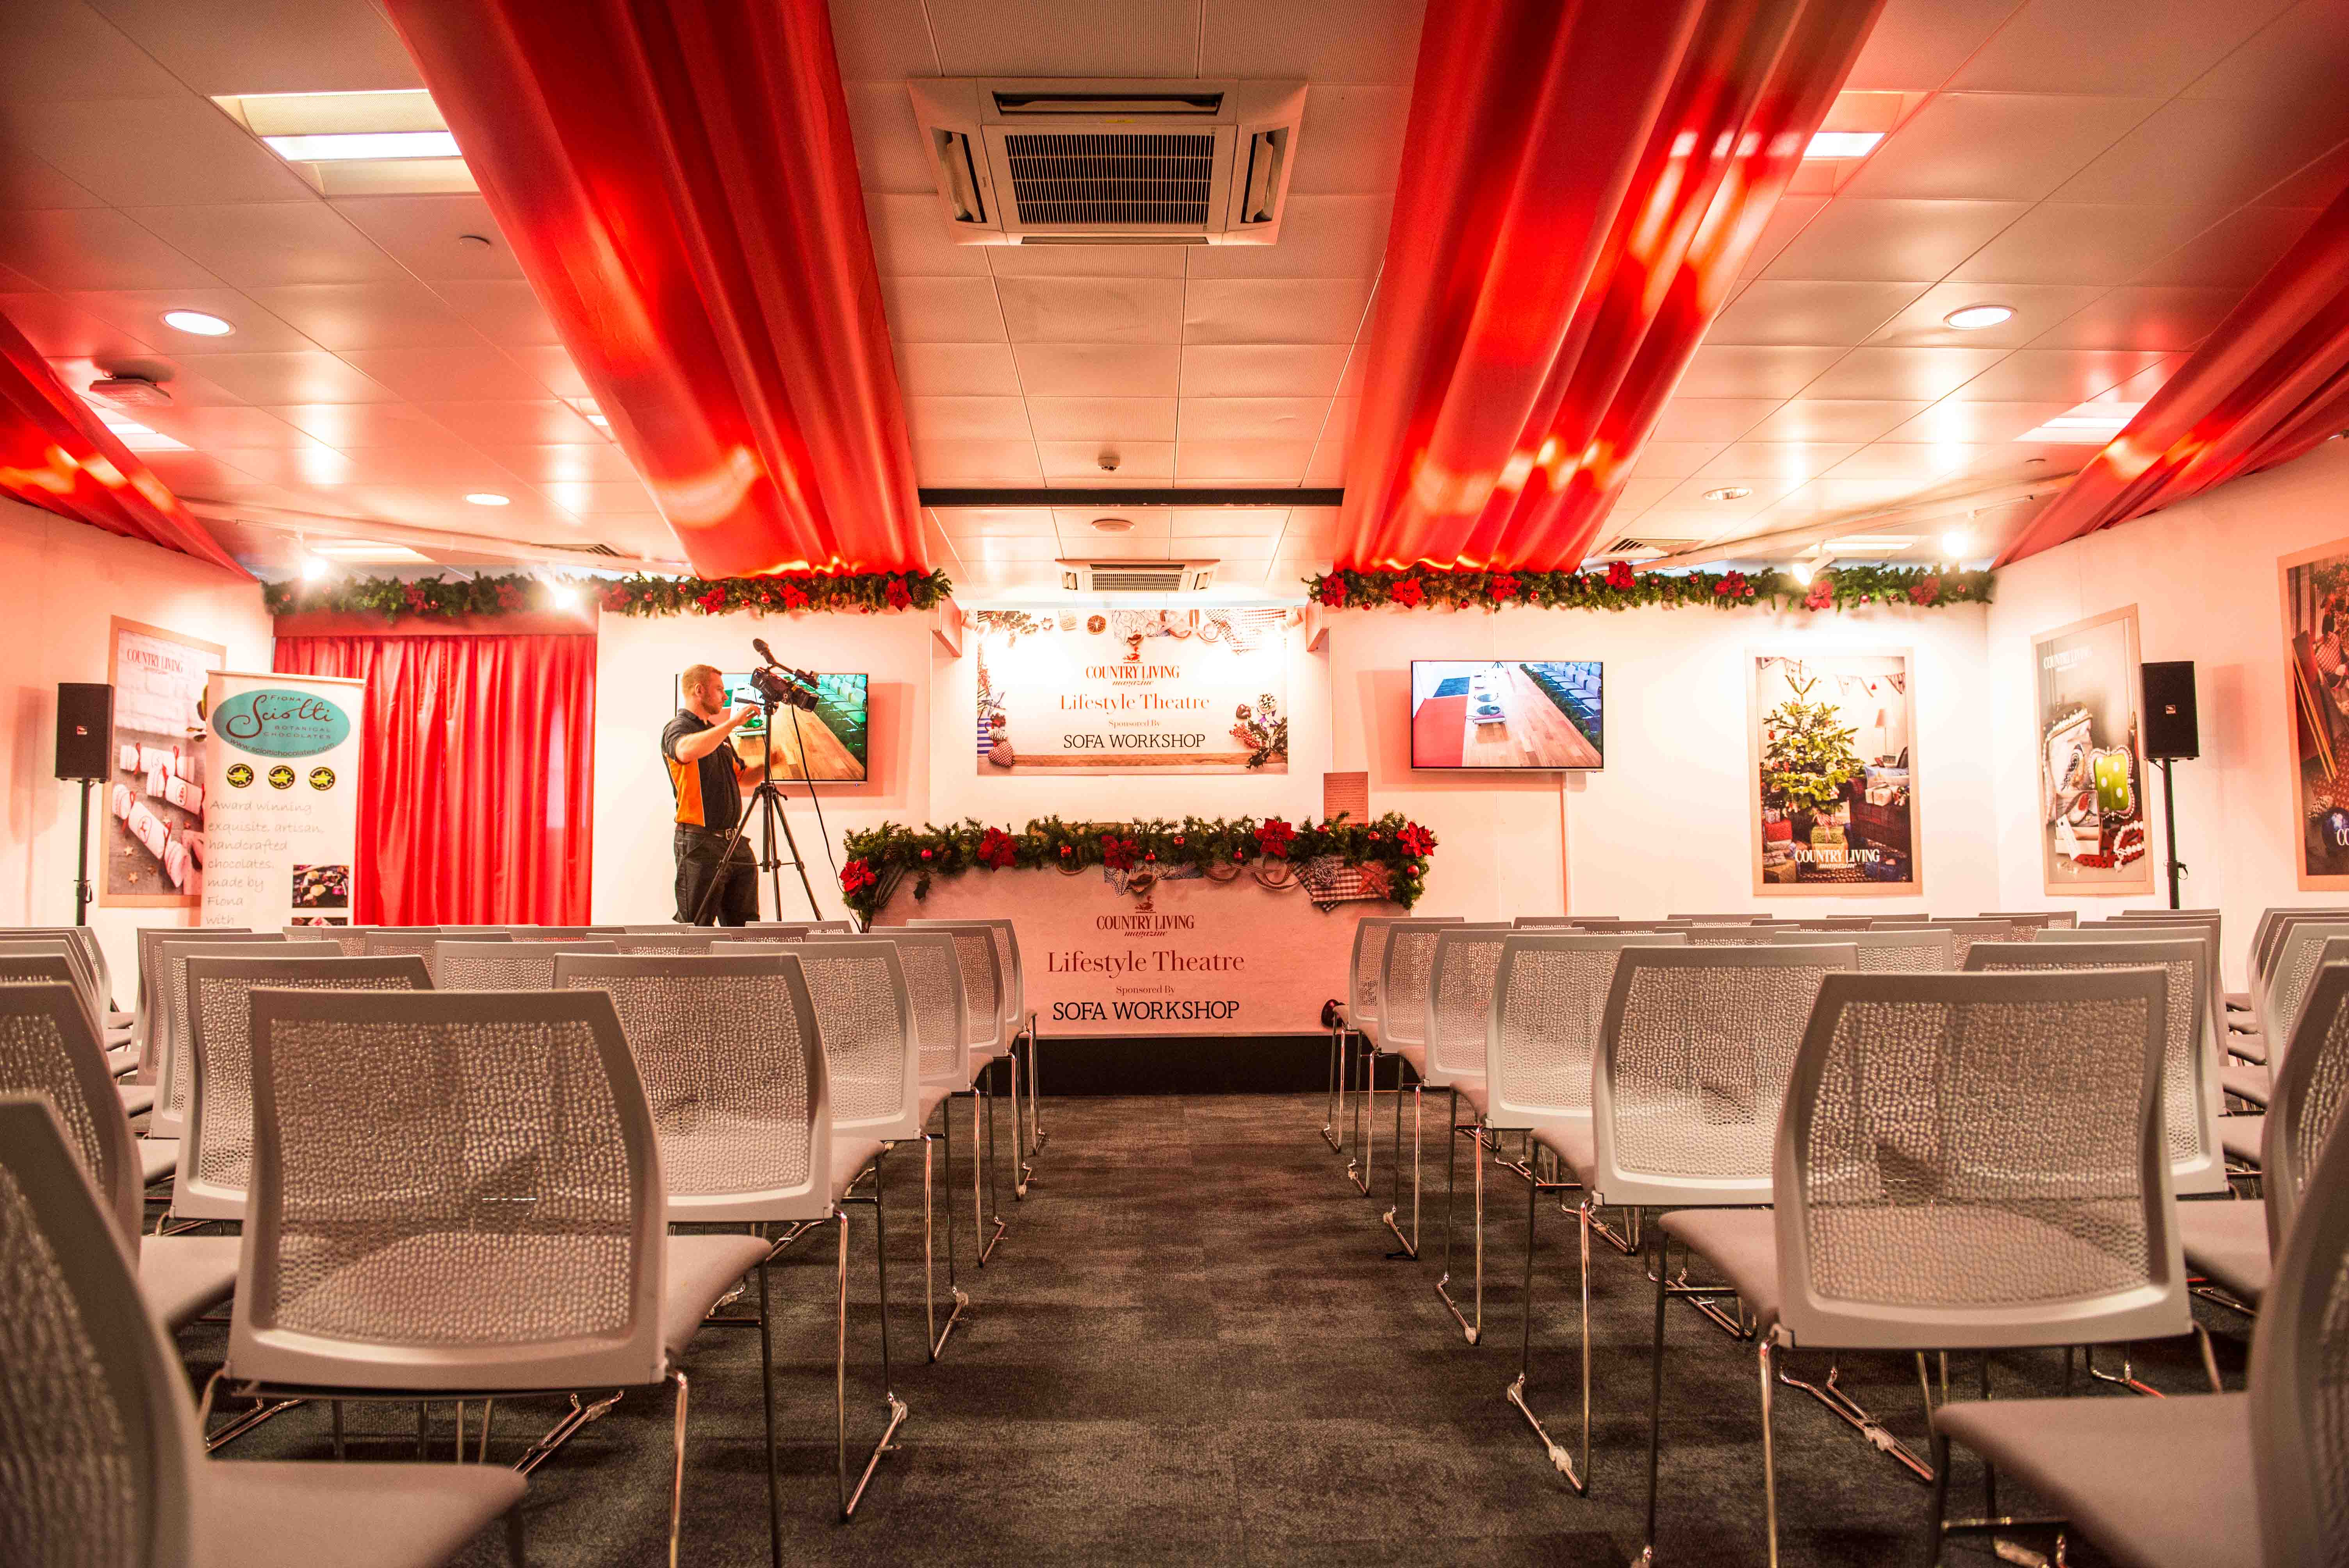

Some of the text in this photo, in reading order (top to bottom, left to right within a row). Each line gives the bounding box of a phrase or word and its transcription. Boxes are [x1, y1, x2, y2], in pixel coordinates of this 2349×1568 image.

[1085, 665, 1180, 679] COUNTRY LIVING
[1060, 693, 1210, 715] Lifestyle Theatre
[1108, 719, 1160, 728] Sponsored By
[1064, 734, 1206, 748] SOFA WORKSHOP
[210, 800, 312, 815] Award winning
[209, 839, 288, 854] handcrafted
[1795, 849, 1880, 863] COUNTRY LIVING
[207, 875, 264, 893] made by
[207, 896, 244, 906] Fiona
[206, 913, 235, 924] with
[1096, 915, 1194, 930] COUNTRY LIVING
[1124, 929, 1168, 937] magazine
[1047, 950, 1245, 978] Lifestyle Theatre
[1116, 985, 1175, 996] Sponsored By
[1053, 1001, 1240, 1021] SOFA WORKSHOP
